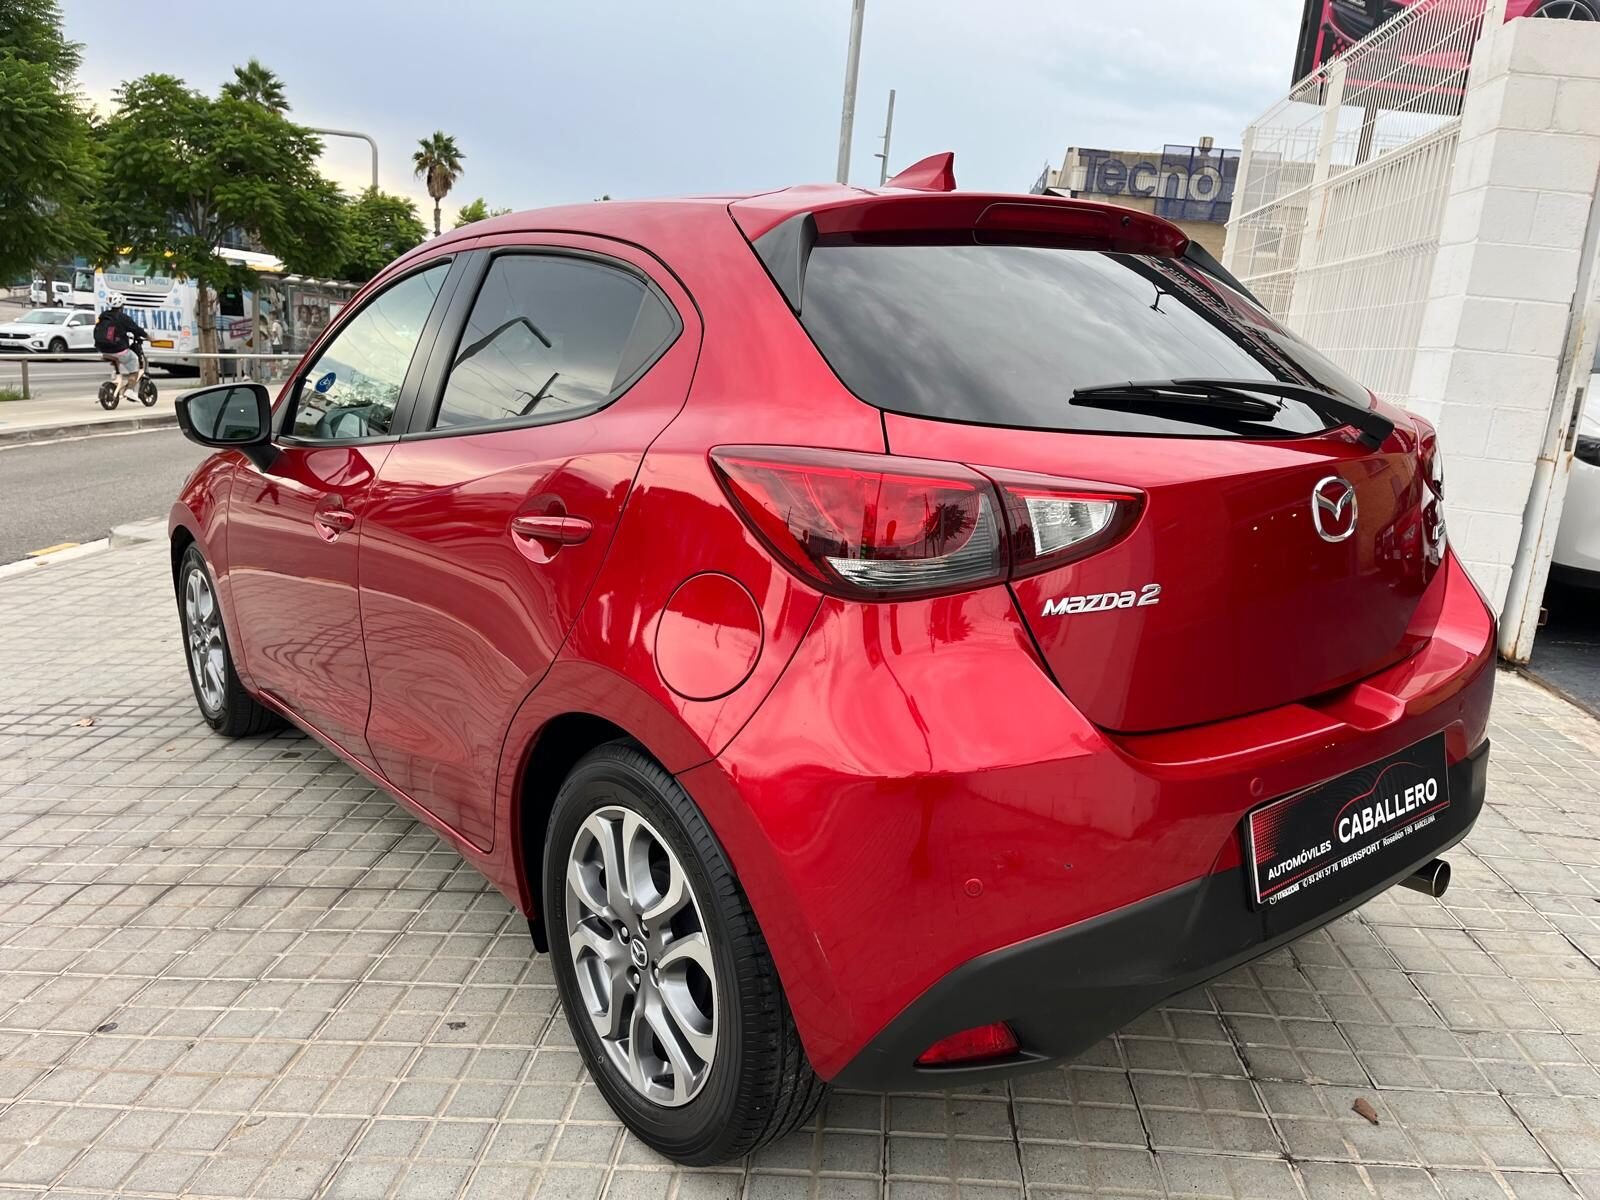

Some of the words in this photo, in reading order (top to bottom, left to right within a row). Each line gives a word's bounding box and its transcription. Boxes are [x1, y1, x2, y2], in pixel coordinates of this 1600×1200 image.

[1079, 148, 1224, 201] Tecno
[1267, 839, 1333, 881] AUTOMÓVILES
[1337, 777, 1439, 844] CABALLERO
[1340, 840, 1381, 868] IBERSPORT
